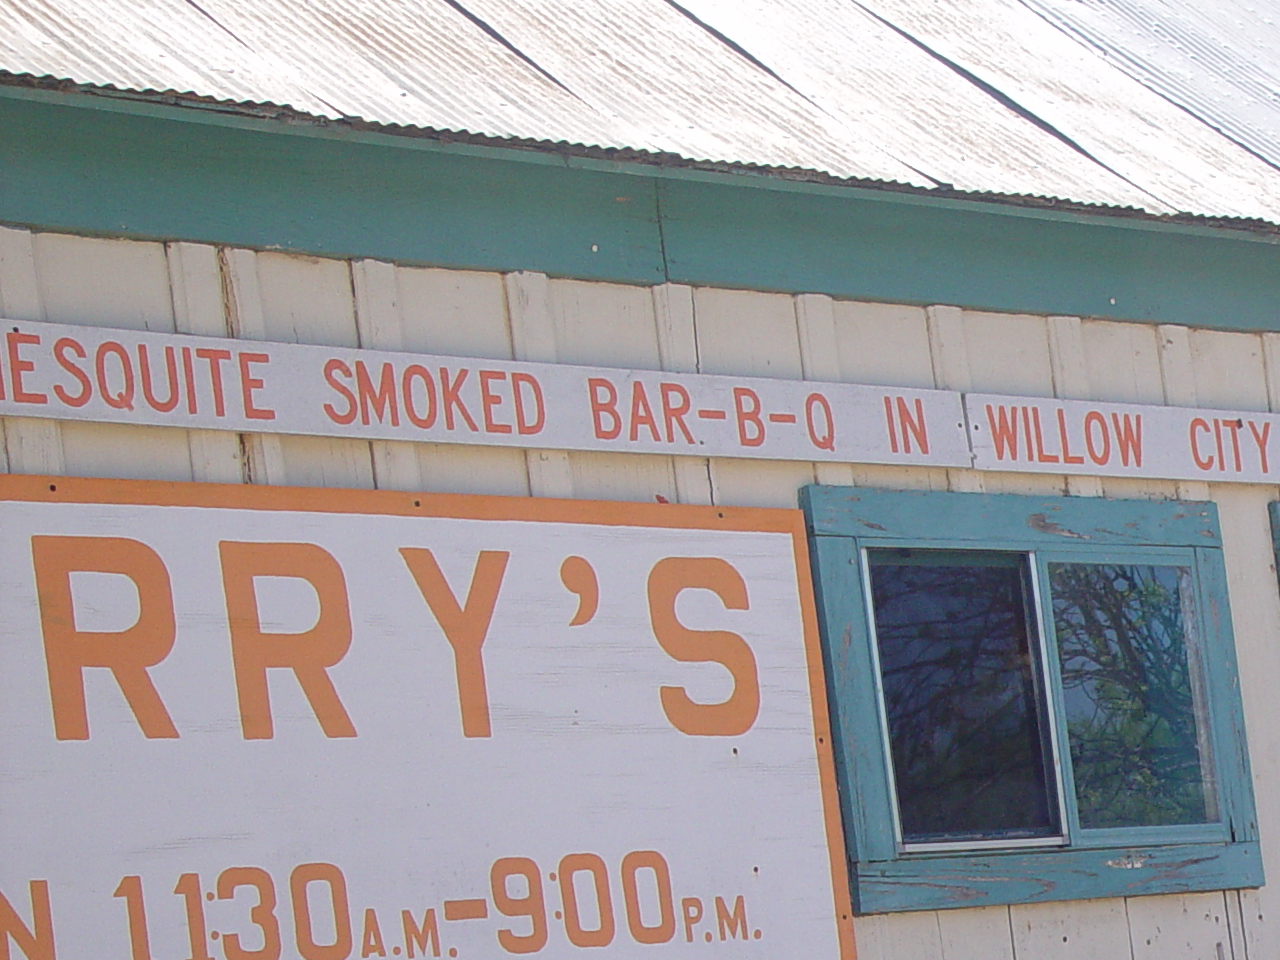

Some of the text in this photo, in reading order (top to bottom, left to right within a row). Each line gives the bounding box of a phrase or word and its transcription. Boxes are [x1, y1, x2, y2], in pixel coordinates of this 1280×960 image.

[0, 331, 275, 420] ESQUITE
[323, 358, 545, 435] SMOKED
[588, 377, 836, 452] BAR-B-Q
[884, 396, 929, 455] IN
[985, 404, 1142, 468] WILLOW
[30, 534, 760, 741] RRY'S
